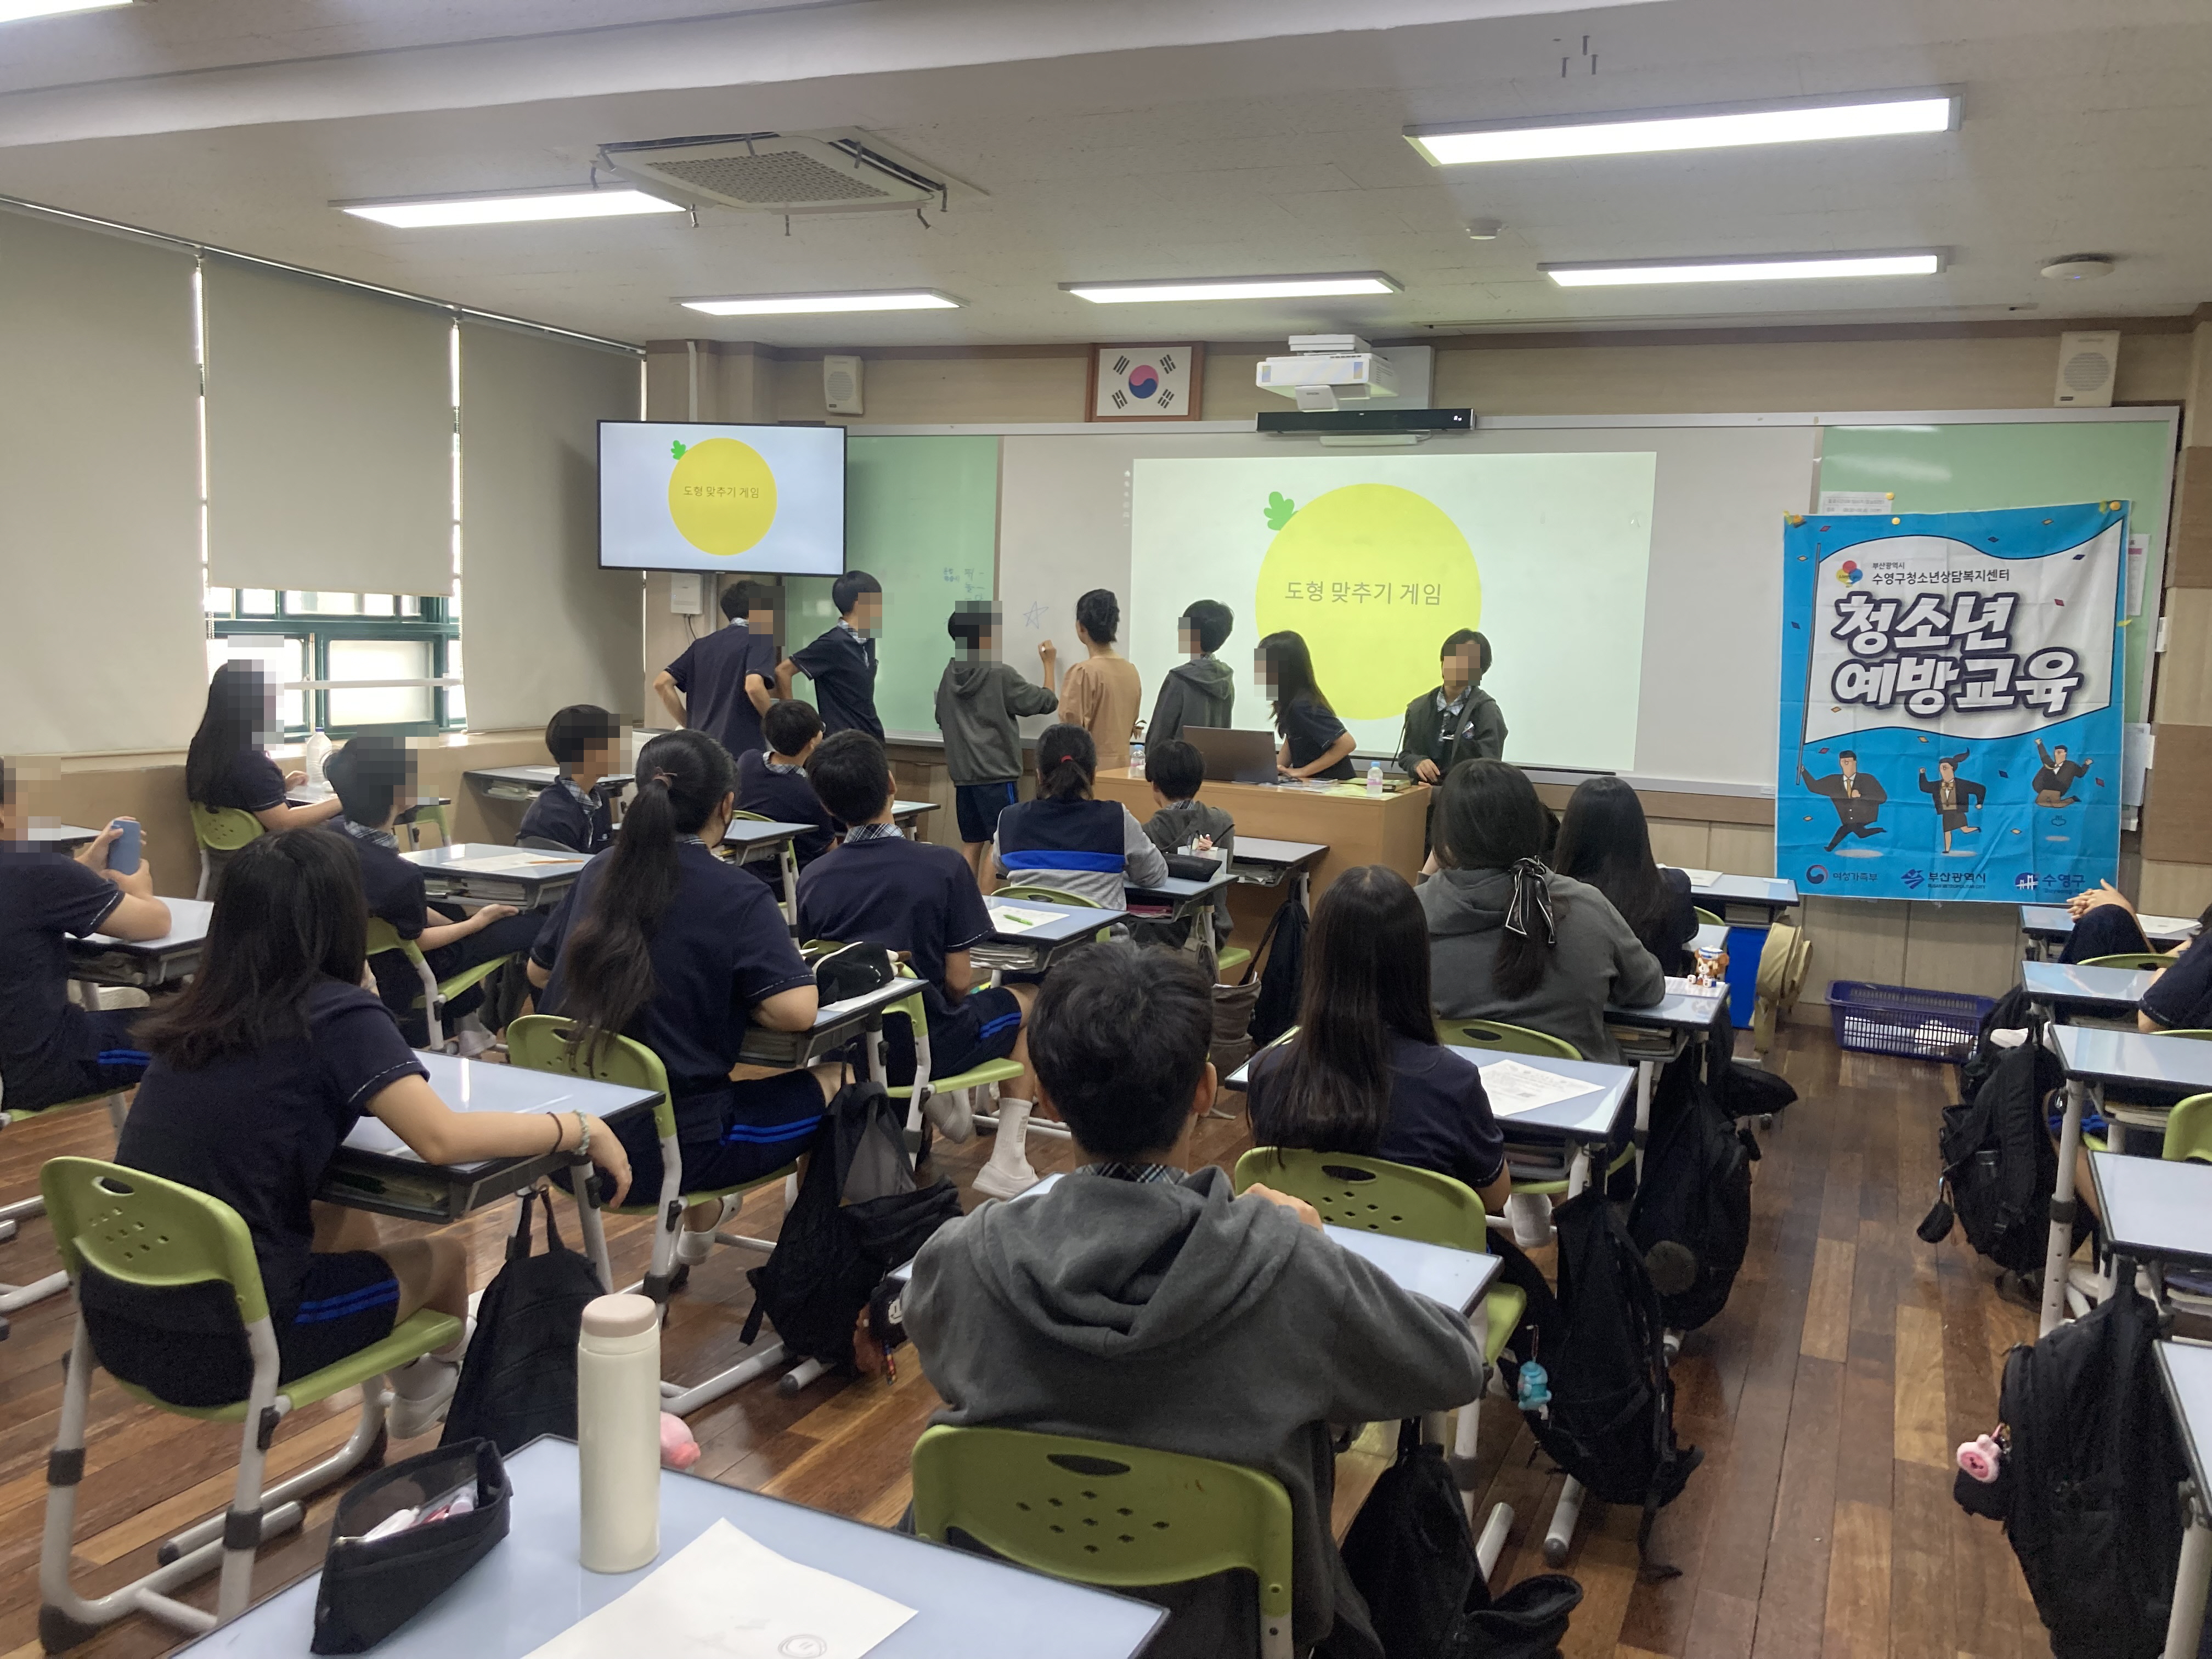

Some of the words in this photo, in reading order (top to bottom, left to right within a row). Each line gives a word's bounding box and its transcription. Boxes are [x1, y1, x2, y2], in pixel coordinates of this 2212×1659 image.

[682, 486, 703, 497] 도형
[706, 486, 736, 498] 맞추기
[739, 487, 760, 499] 게임
[1872, 568, 2010, 585] 수영구청소년상담복지센터
[1284, 580, 1324, 602] 도형
[1331, 581, 1392, 605] 맞추기
[1399, 583, 1442, 606] 게임
[1832, 592, 2018, 657] 청소년
[1832, 648, 2083, 717] 예방교육
[1833, 871, 1878, 882] 여성가족부
[1928, 872, 1986, 883] 부산광역시
[2041, 873, 2086, 888] 수영구
